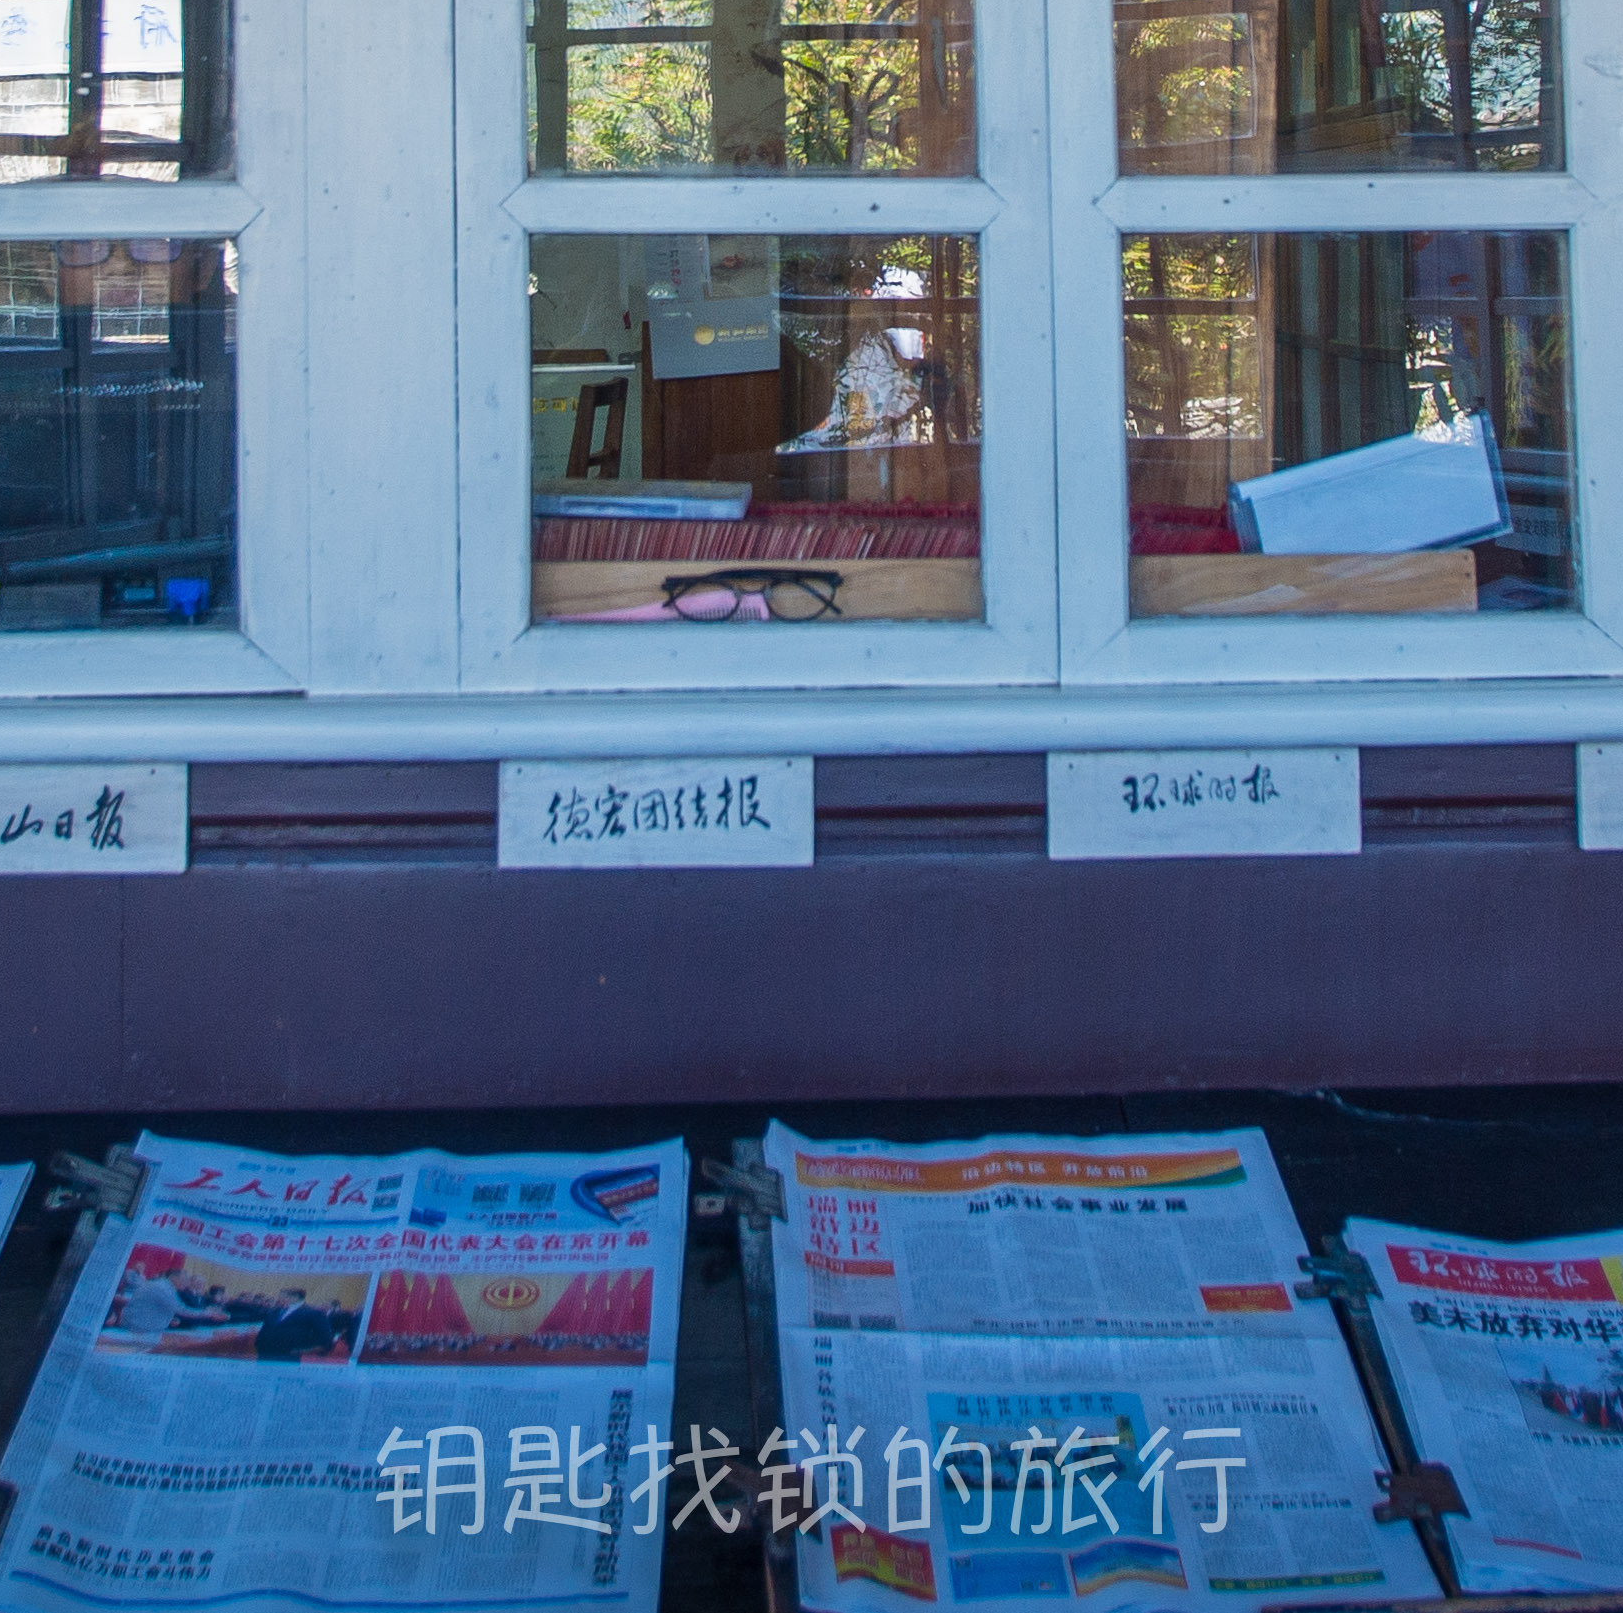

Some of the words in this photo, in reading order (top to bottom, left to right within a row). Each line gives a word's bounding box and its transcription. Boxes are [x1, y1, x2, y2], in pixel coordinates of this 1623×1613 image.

[543, 775, 770, 844] 德宏团结报
[163, 1167, 371, 1207] 工人日报
[967, 1197, 1187, 1214] 加快社会事业发展
[152, 1212, 650, 1251] 中国工会第十七次全国代表大会在京开幕
[1408, 1249, 1588, 1286] 环球时报
